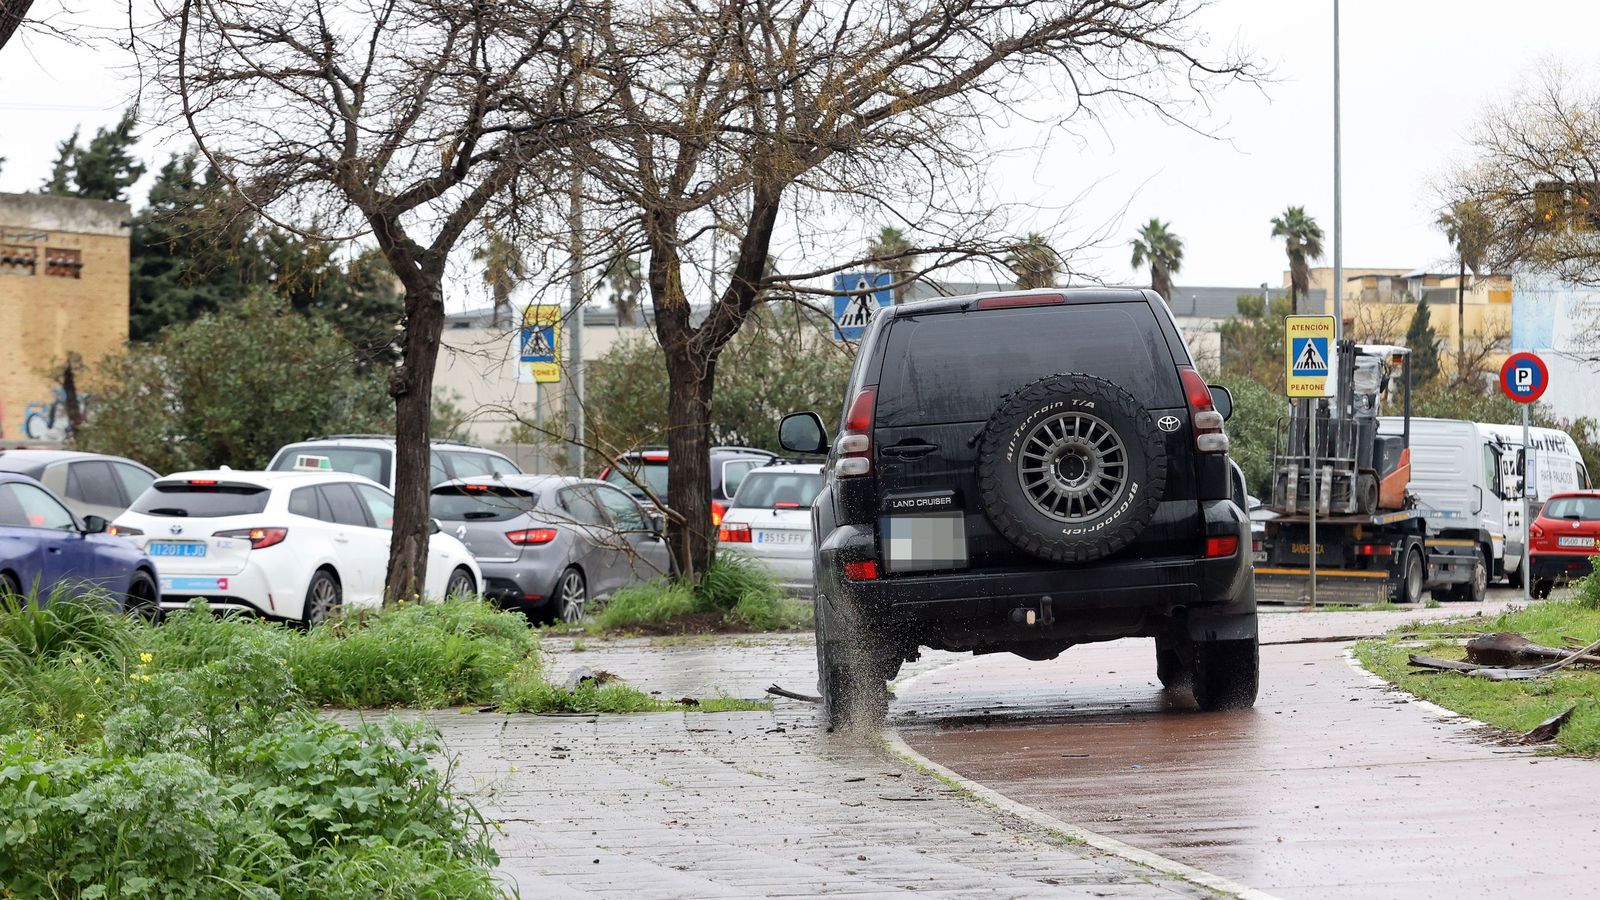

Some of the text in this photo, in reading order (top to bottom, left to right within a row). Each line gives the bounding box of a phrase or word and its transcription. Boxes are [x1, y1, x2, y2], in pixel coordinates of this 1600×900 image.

[1291, 321, 1329, 331] ATENCIÓN
[1518, 370, 1529, 383] P
[1007, 399, 1096, 463] All-Terrain T/A
[893, 497, 952, 508] LAND CRUISER
[1062, 481, 1139, 536] BFGoodrich
[765, 533, 786, 542] 3515
